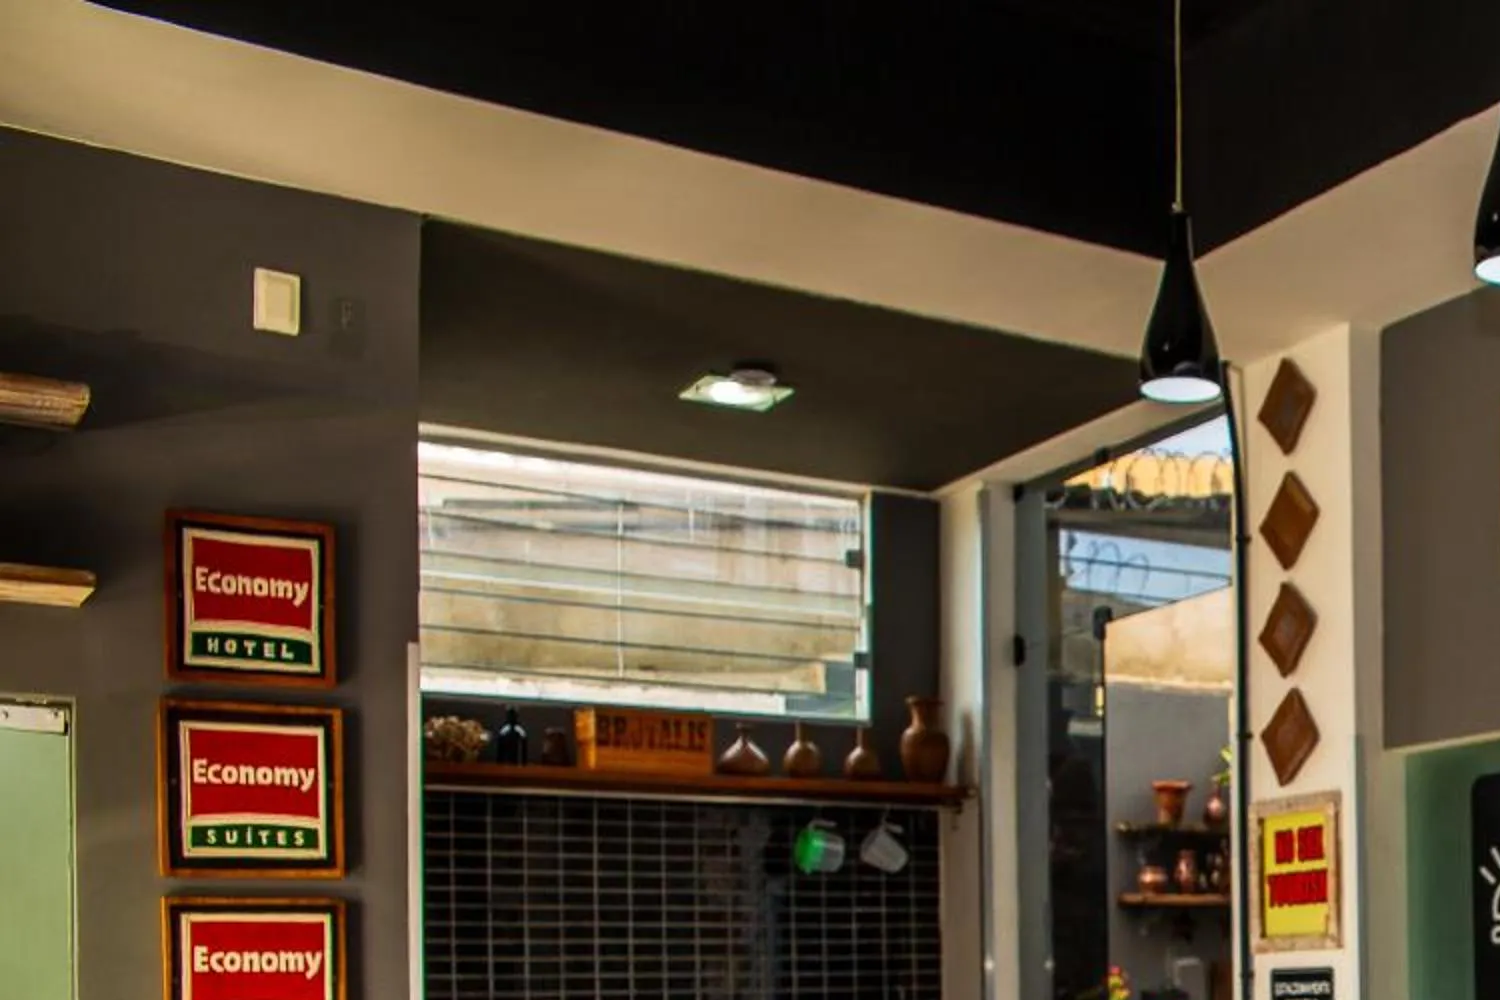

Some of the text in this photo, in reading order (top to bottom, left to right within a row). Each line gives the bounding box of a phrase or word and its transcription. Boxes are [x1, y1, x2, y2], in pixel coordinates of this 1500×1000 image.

[194, 566, 311, 607] Economy
[206, 636, 295, 660] HOTEL
[192, 758, 316, 792] Economy
[193, 945, 323, 979] Economy
